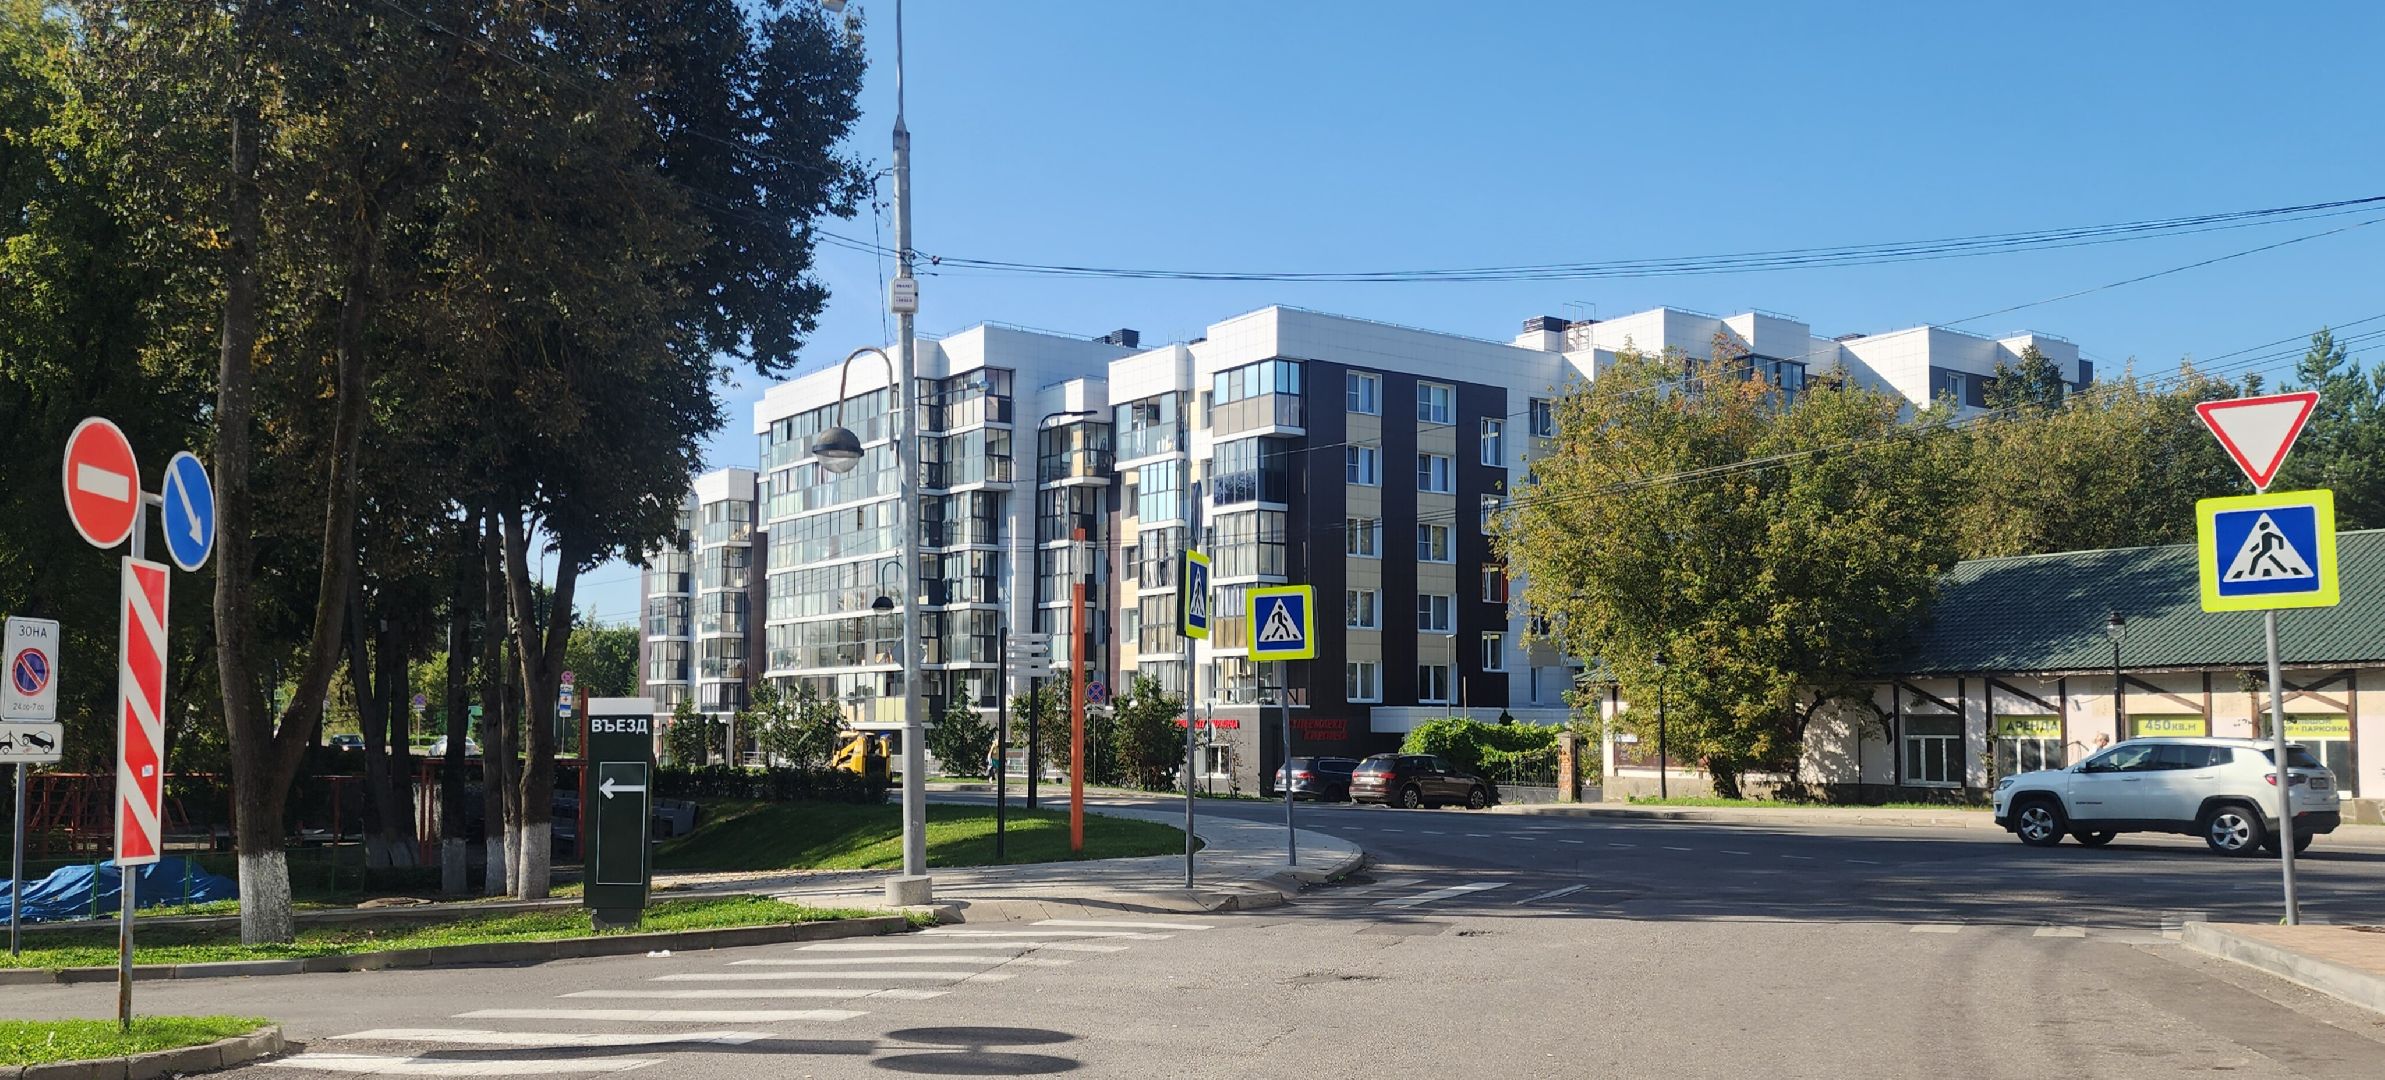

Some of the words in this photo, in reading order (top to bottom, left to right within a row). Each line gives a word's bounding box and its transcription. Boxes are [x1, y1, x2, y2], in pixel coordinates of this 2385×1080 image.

[19, 625, 47, 638] ЗОНА
[591, 719, 648, 734] ВЪЕЗД
[2006, 720, 2059, 732] АРЕНДА
